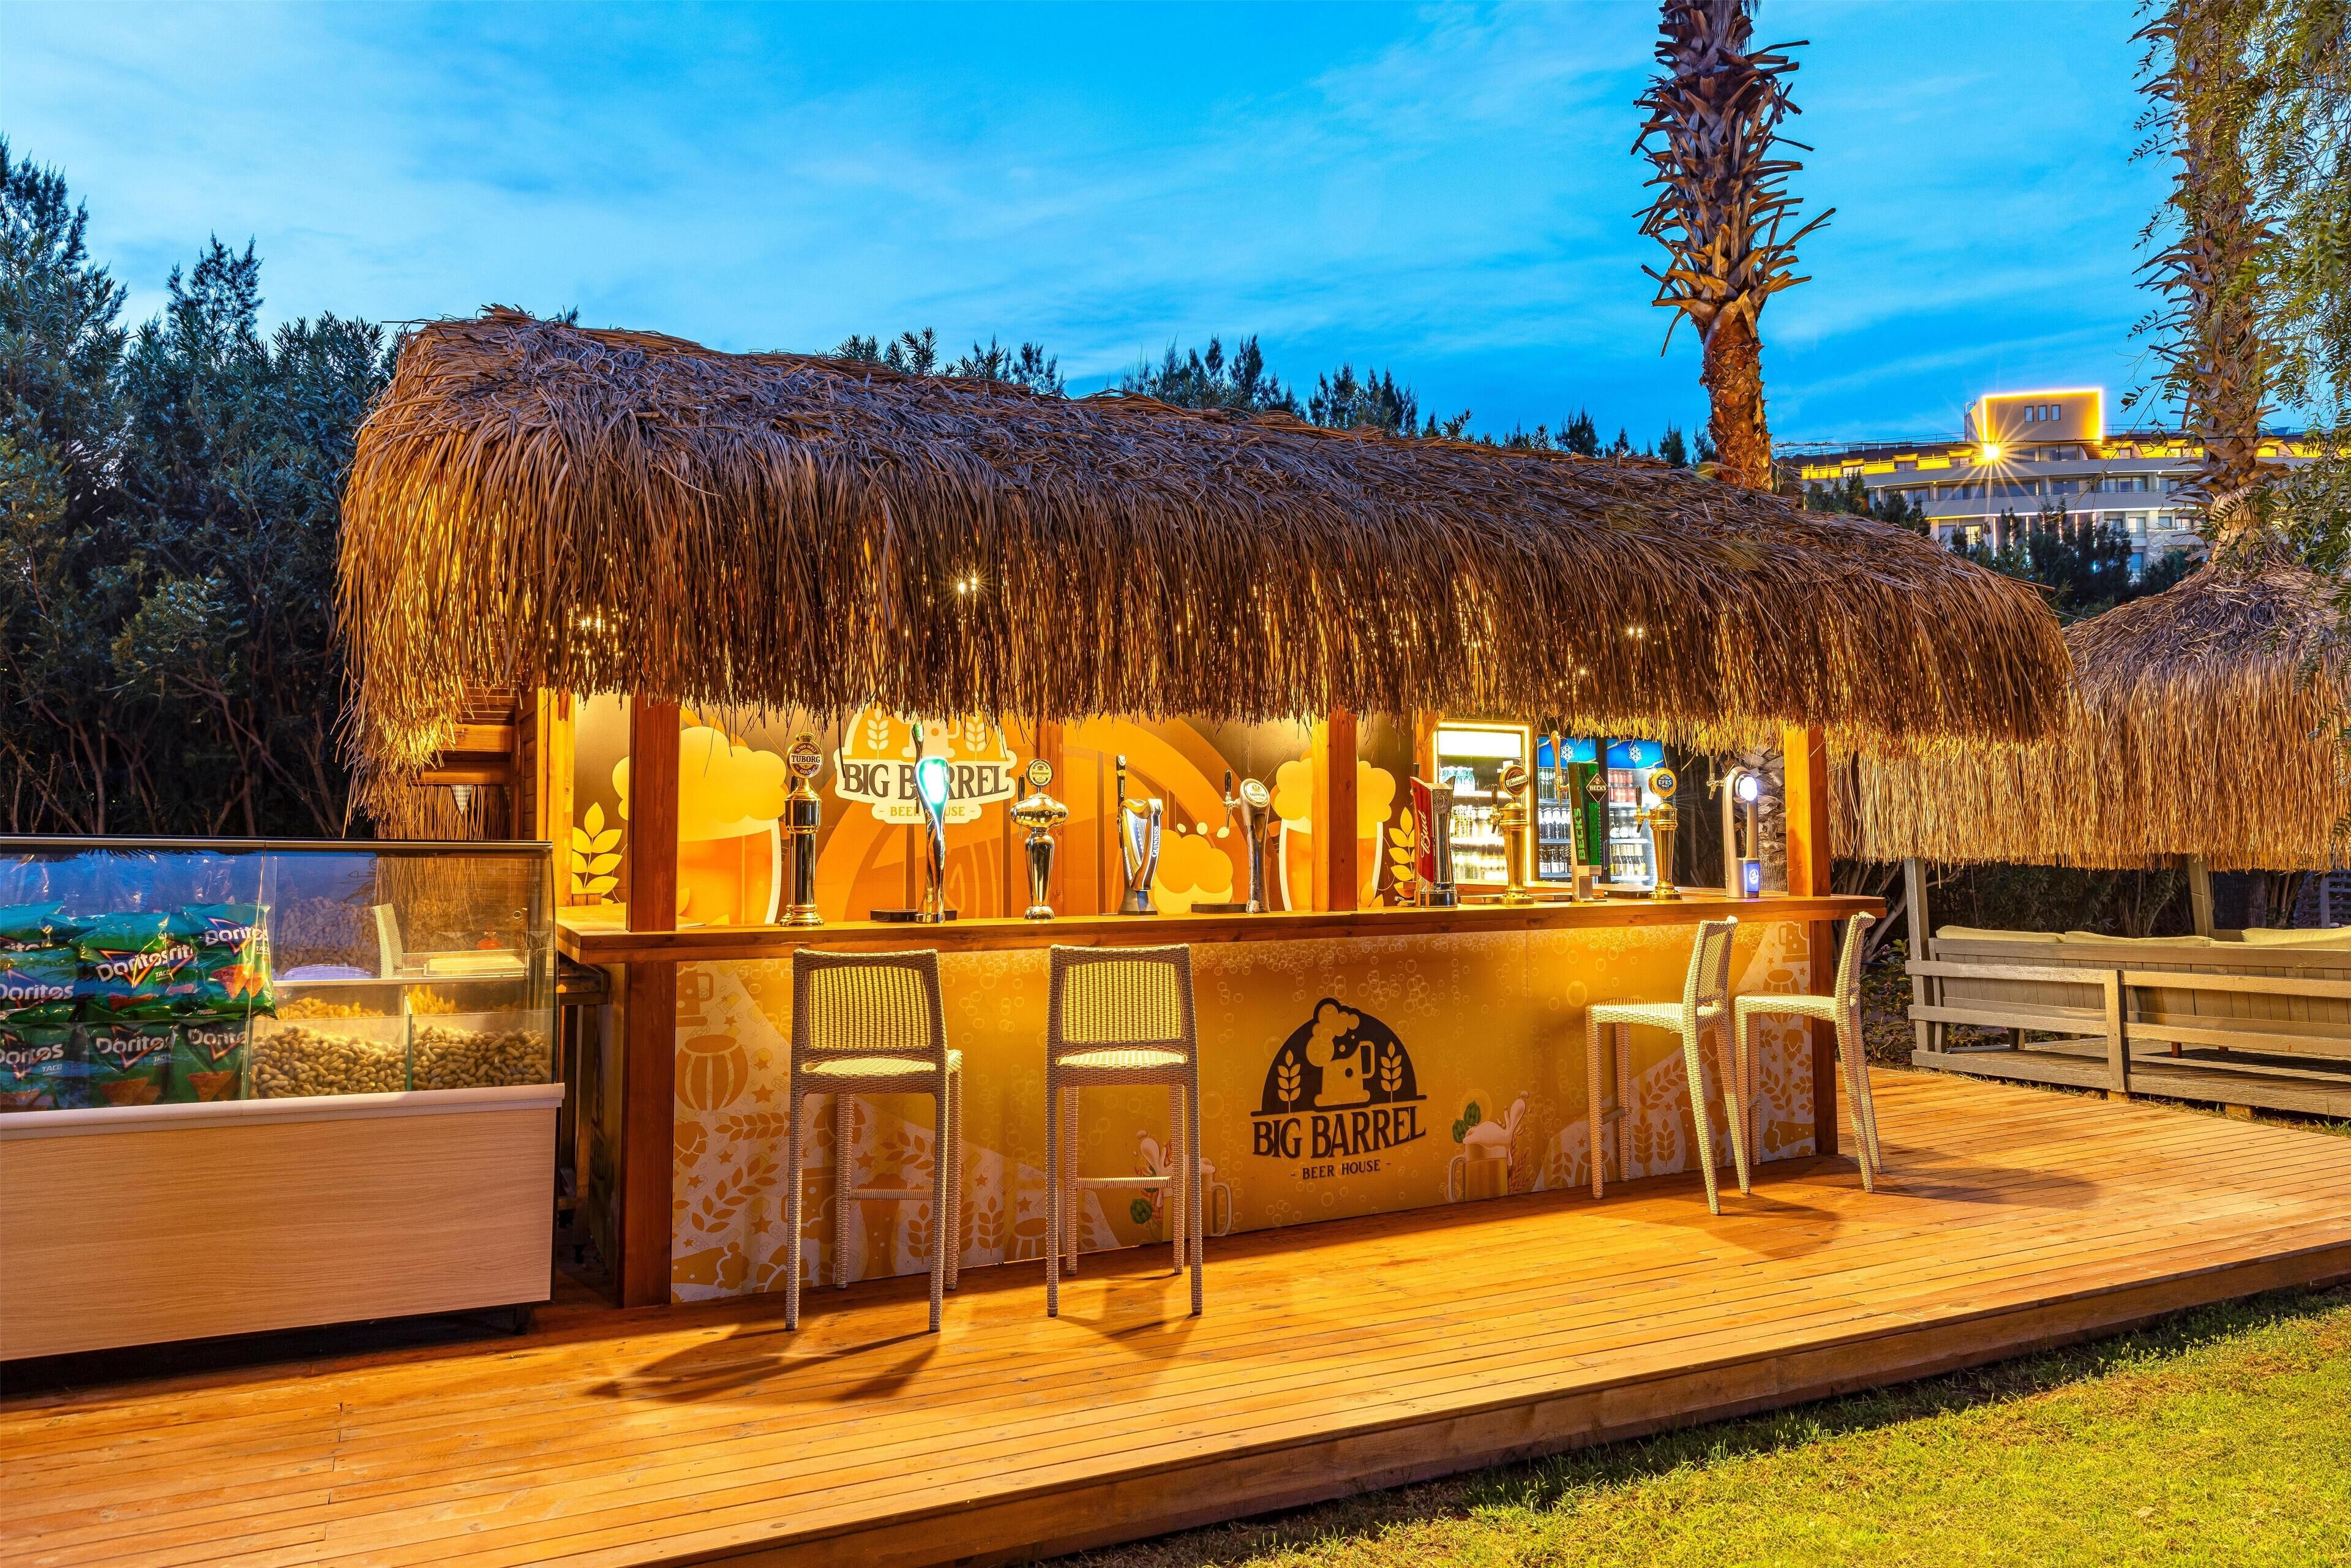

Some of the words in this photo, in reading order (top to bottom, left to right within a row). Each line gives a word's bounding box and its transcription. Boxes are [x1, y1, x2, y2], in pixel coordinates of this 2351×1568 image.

[791, 755, 820, 763] TUBORG
[842, 763, 890, 798] BIG
[898, 765, 1010, 800] BREL
[1151, 825, 1160, 858] GUINNESS
[1418, 809, 1431, 858] Bud
[1573, 808, 1586, 860] BECK'S
[96, 950, 168, 982] Doritos
[188, 1029, 246, 1045] Dorito
[42, 1064, 62, 1073] TACO
[1252, 1117, 1302, 1158] BIG
[1310, 1106, 1426, 1158] BARREL
[1302, 1165, 1334, 1180] BEER
[1341, 1160, 1381, 1175] HOUSE
